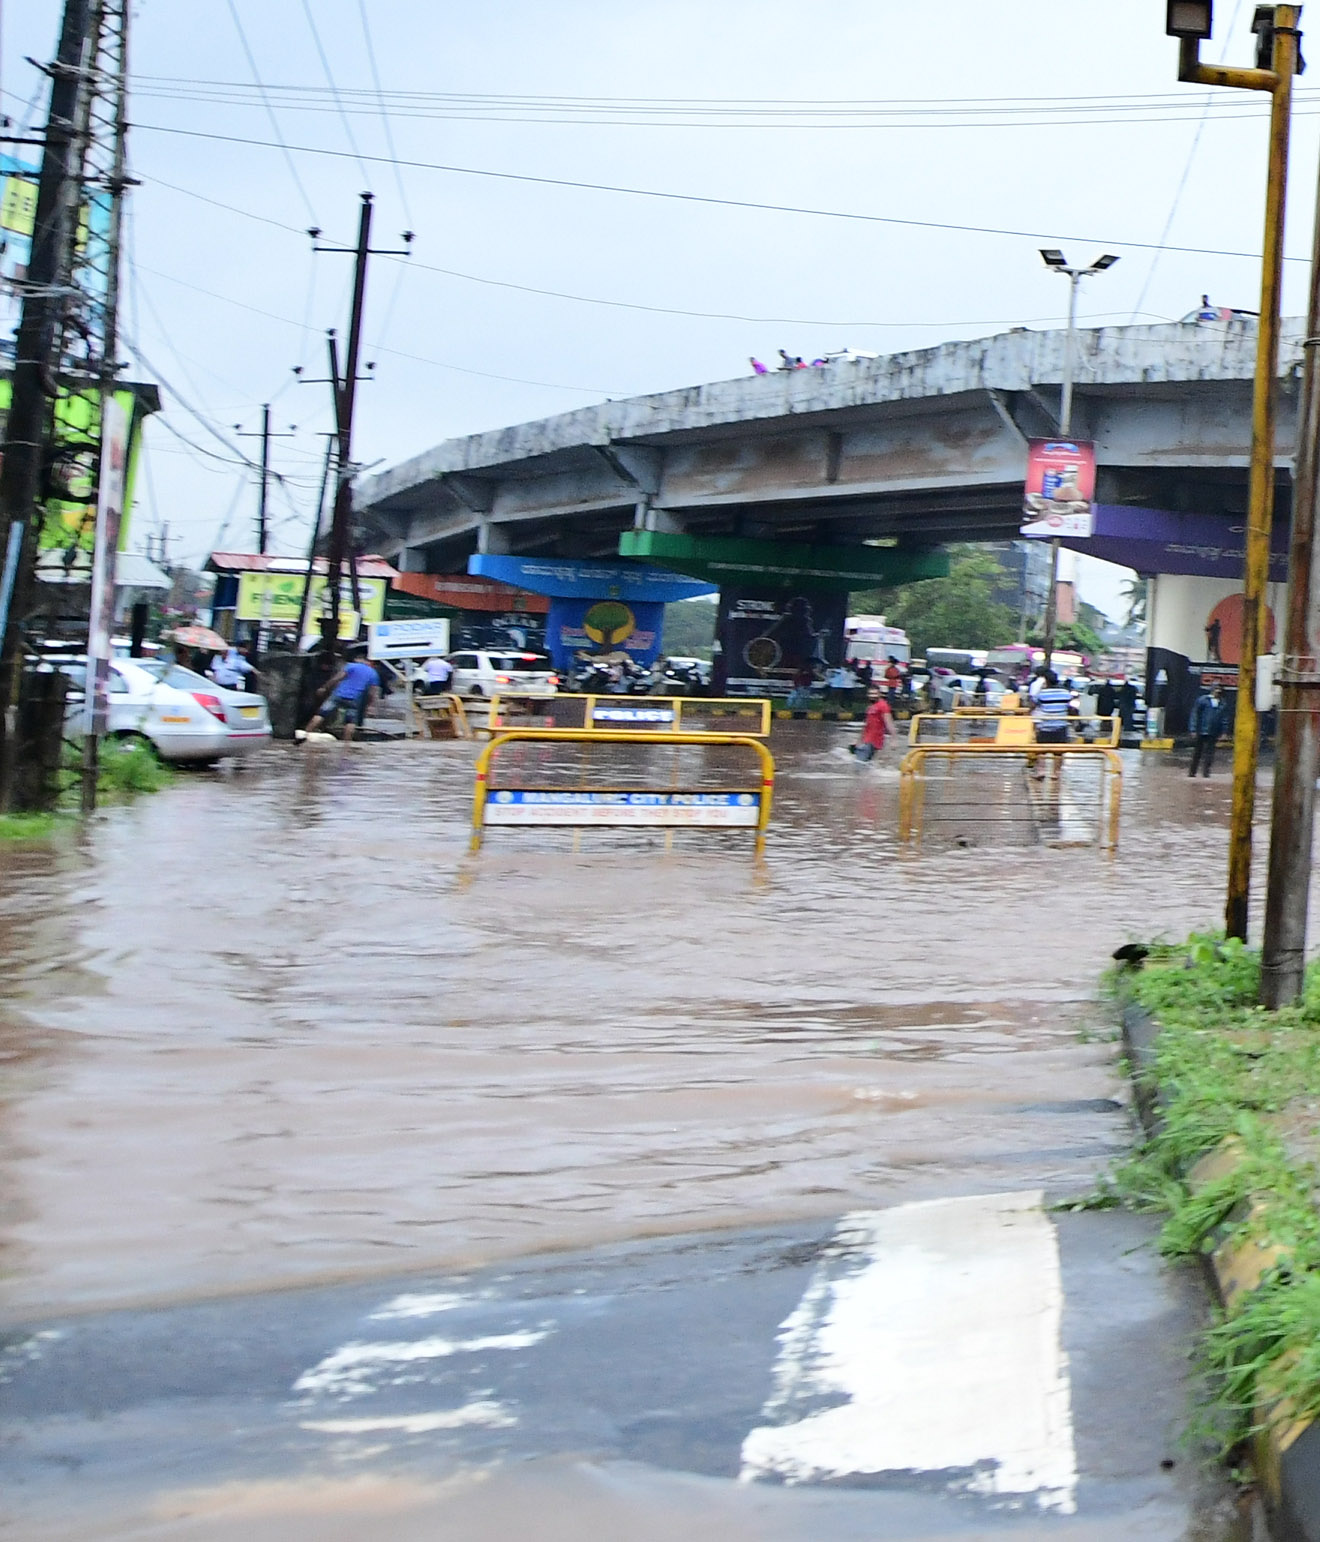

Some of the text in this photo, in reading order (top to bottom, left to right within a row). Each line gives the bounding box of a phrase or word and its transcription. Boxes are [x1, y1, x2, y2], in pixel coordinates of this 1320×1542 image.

[593, 710, 674, 722] POLICE
[629, 793, 670, 805] CITY
[671, 794, 731, 806] POLICE
